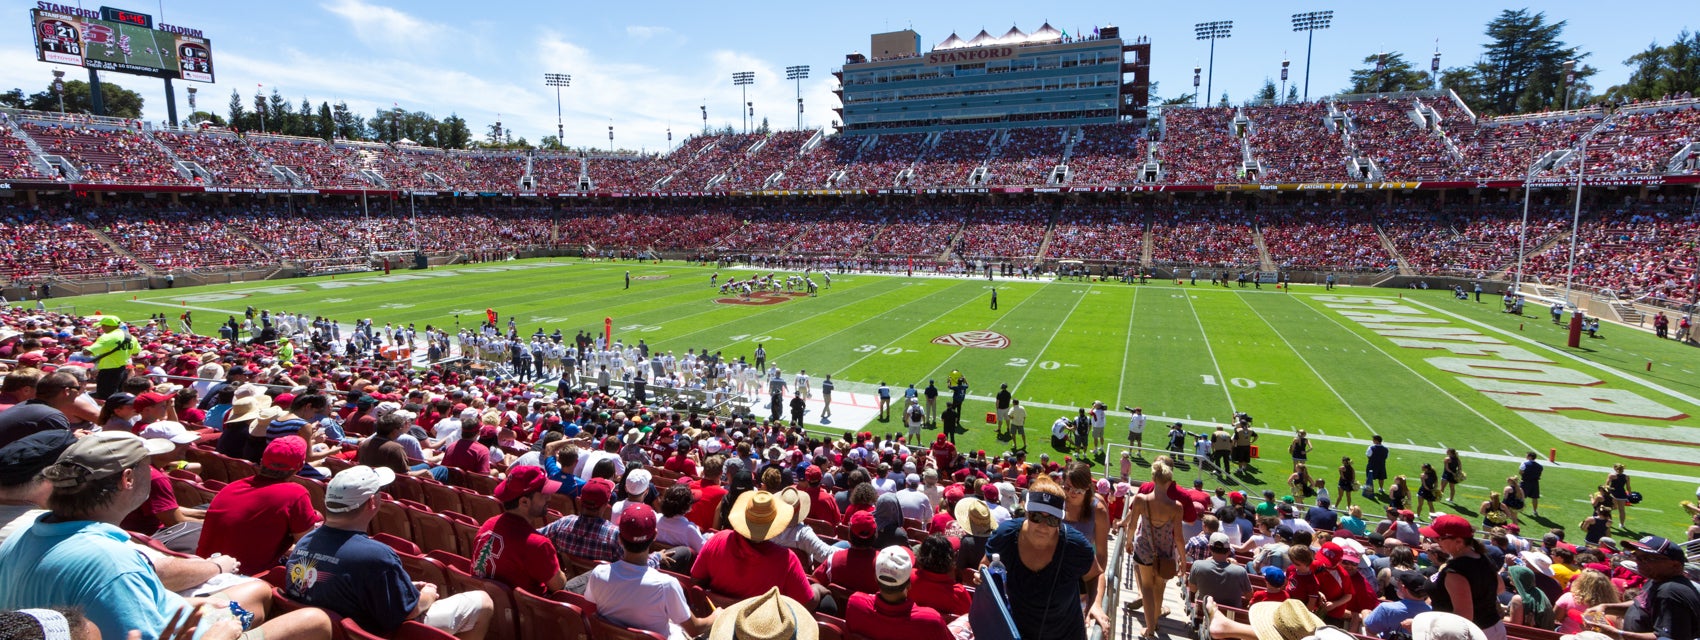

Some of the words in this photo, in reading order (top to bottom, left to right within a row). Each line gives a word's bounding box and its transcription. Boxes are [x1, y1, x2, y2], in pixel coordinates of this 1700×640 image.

[37, 1, 100, 20] STANFORD
[40, 10, 73, 20] STANFORD
[119, 11, 145, 25] 6:46
[57, 26, 75, 38] 21
[158, 22, 203, 38] STADIUM
[48, 42, 55, 51] 1
[65, 44, 80, 54] 10
[185, 47, 193, 57] 0
[929, 47, 1012, 64] STANFORD
[183, 62, 195, 71] 46
[202, 65, 208, 73] 2
[619, 324, 663, 332] 50
[729, 333, 773, 343] 40
[853, 344, 903, 355] 30
[1004, 357, 1061, 371] 20
[1200, 374, 1257, 389] 10
